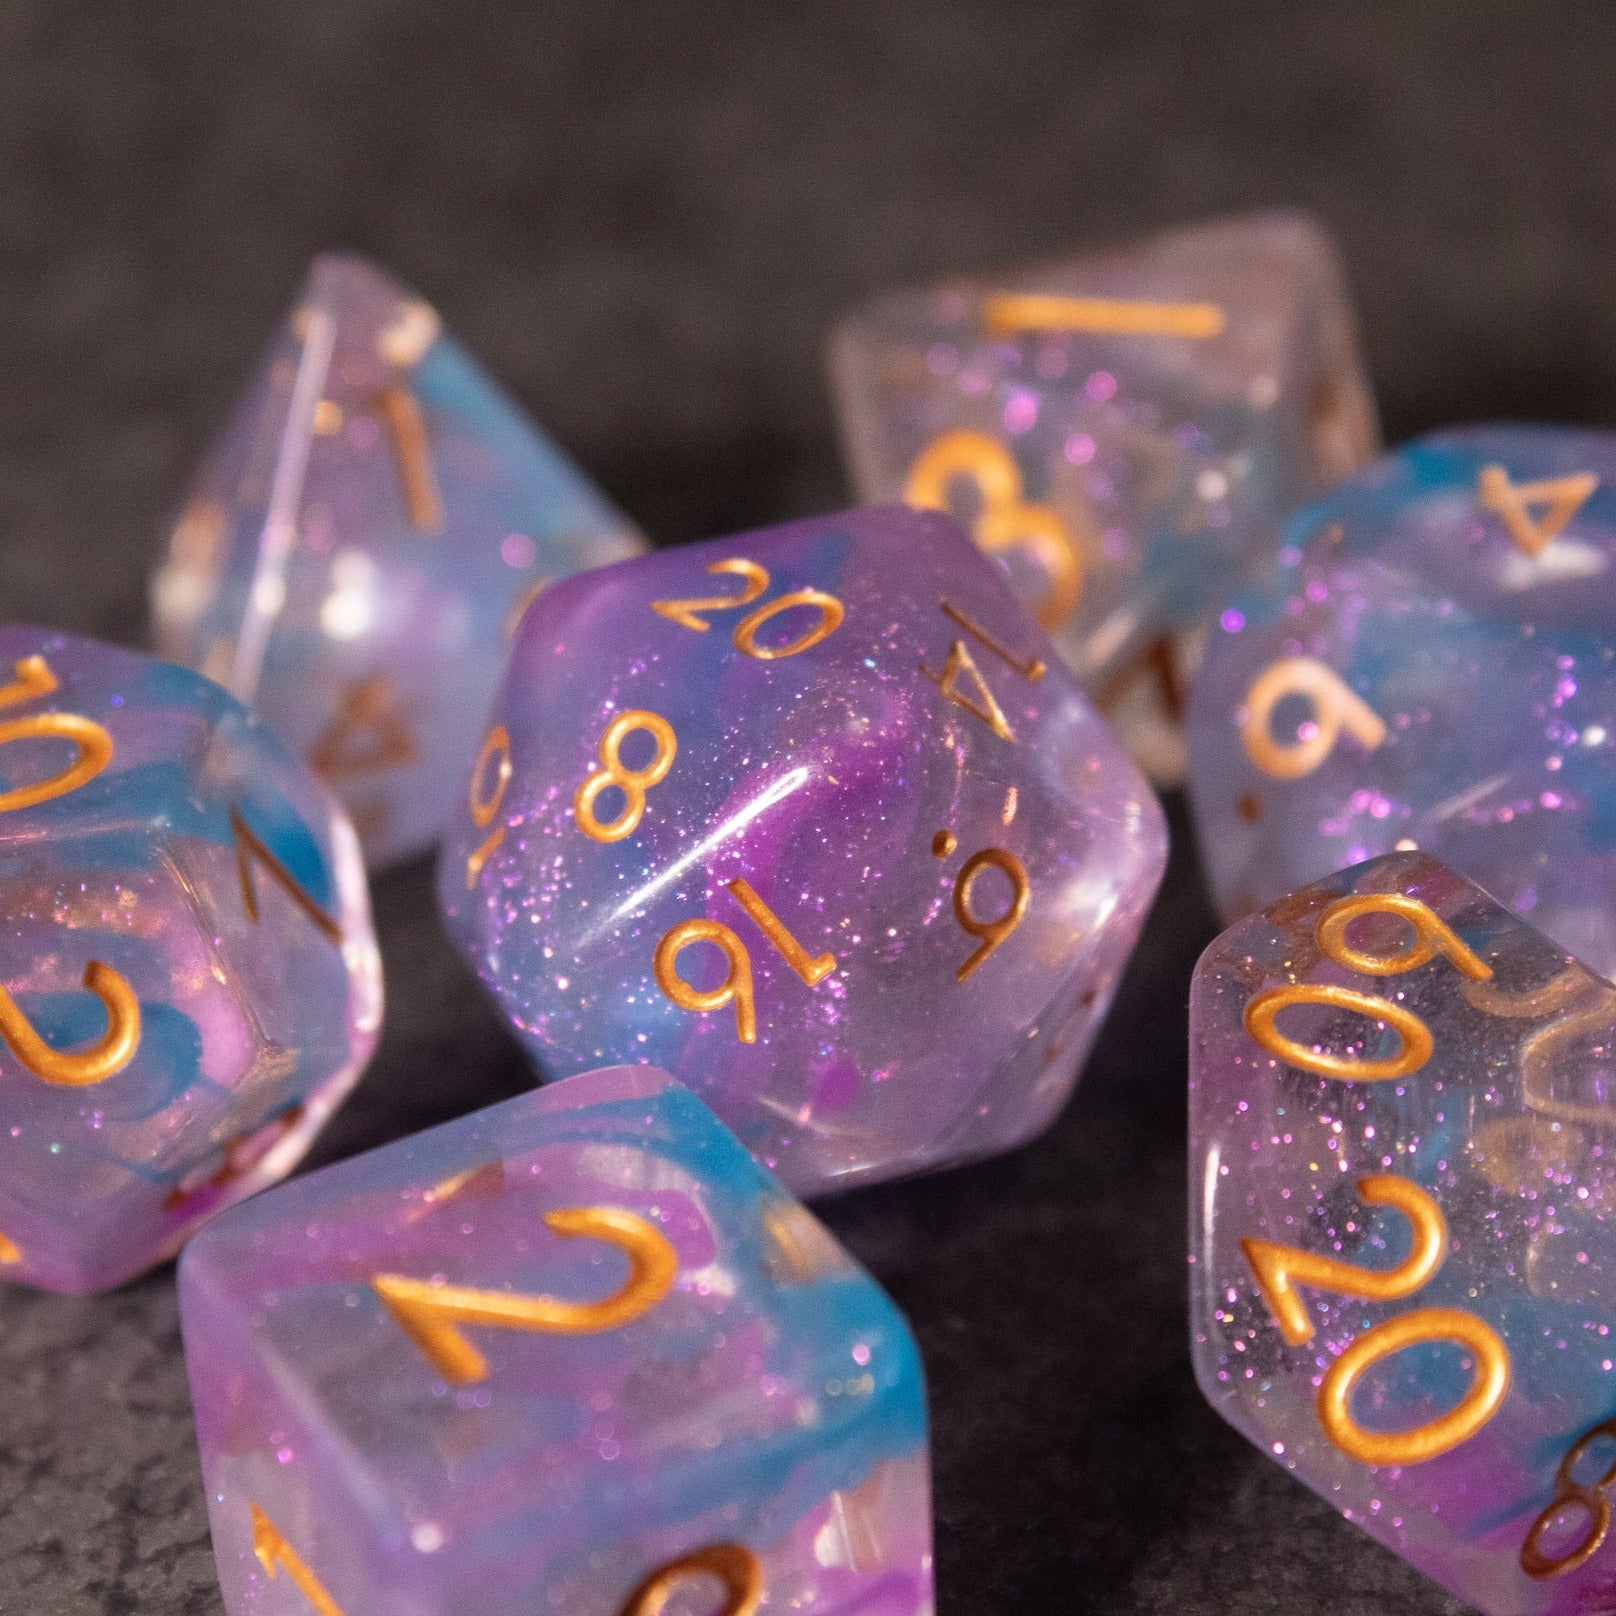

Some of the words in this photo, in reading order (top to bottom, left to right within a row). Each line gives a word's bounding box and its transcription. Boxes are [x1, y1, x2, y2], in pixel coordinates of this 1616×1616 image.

[1480, 465, 1600, 557] 4
[651, 557, 845, 660] 20
[573, 709, 678, 844] 8
[370, 1206, 678, 1386] 2
[1240, 1173, 1511, 1467] 20
